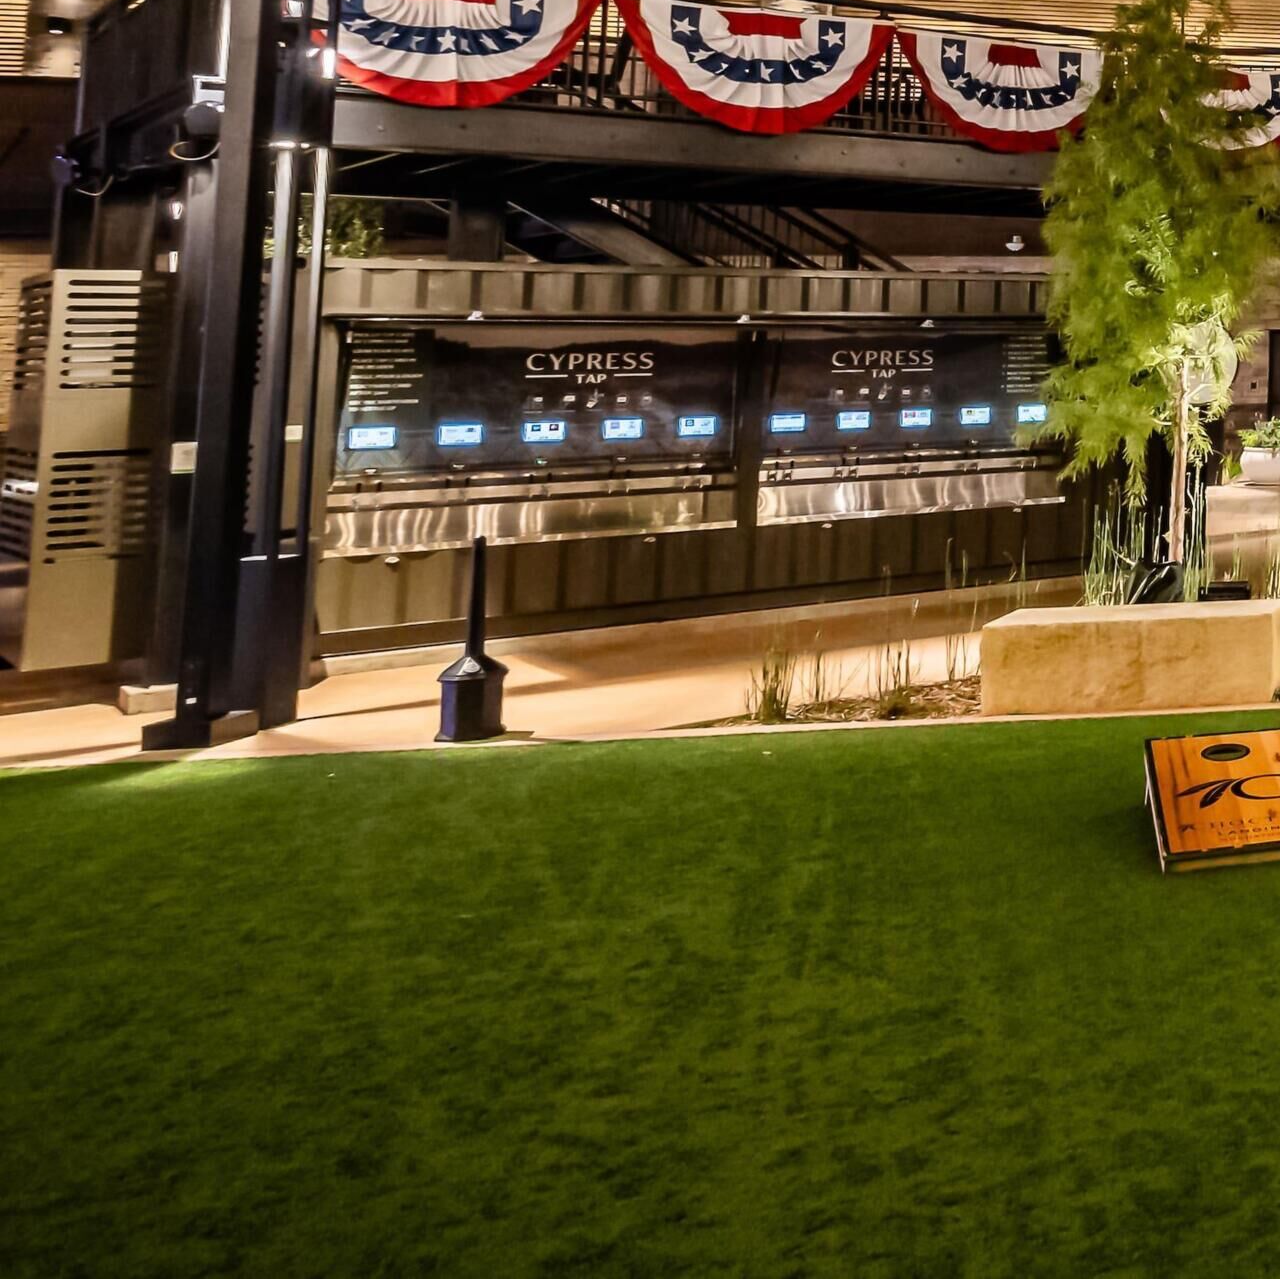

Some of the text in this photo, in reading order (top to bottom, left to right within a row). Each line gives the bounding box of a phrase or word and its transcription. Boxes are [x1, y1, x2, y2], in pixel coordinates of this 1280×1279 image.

[526, 352, 654, 371] CYPRESS
[831, 350, 934, 367] CYPRESS
[575, 373, 607, 385] TAP
[871, 369, 897, 379] TAP
